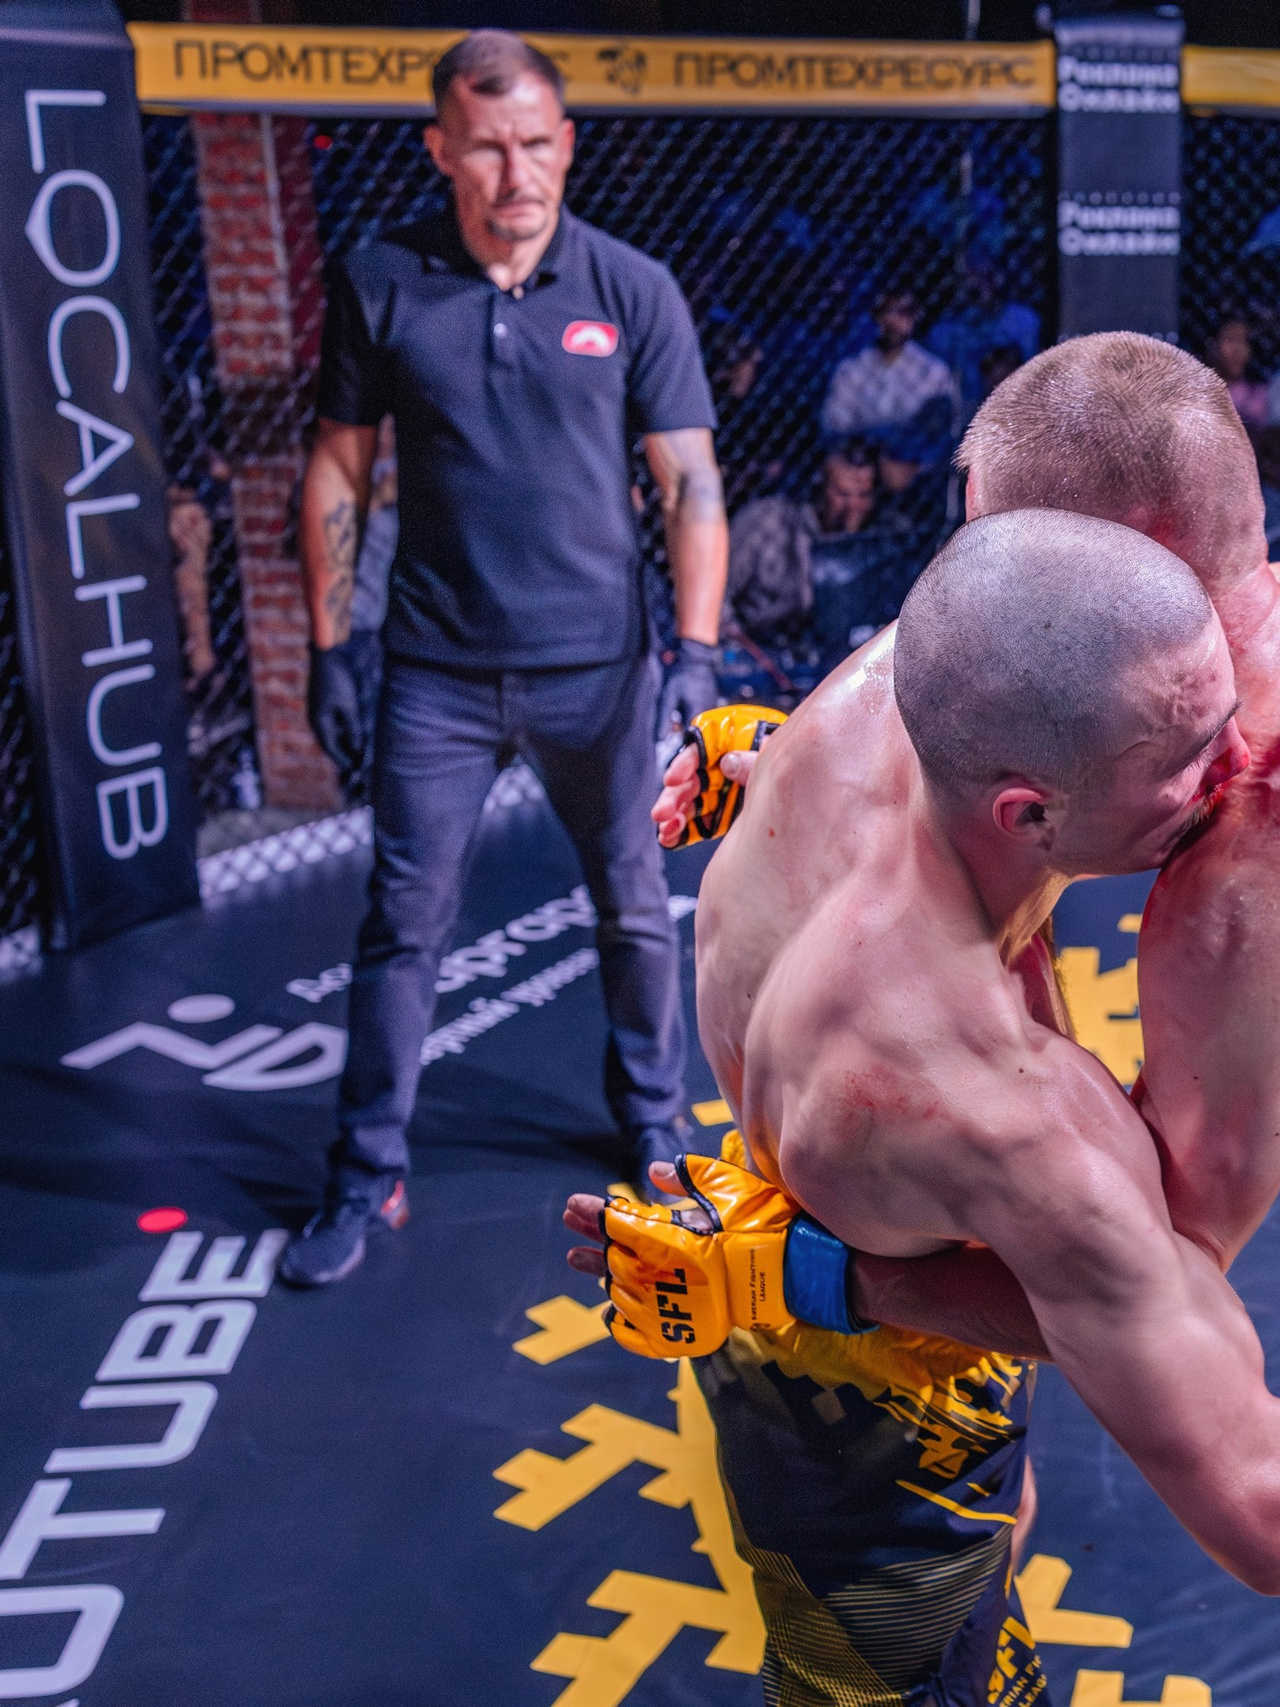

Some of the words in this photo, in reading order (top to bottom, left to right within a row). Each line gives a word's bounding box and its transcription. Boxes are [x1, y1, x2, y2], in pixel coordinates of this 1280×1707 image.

[673, 51, 1036, 91] ПРОМТЕХРЕСУРС
[25, 89, 169, 861] LOCALHUB
[655, 1267, 696, 1344] SFL
[0, 1228, 290, 1707] UTUBE
